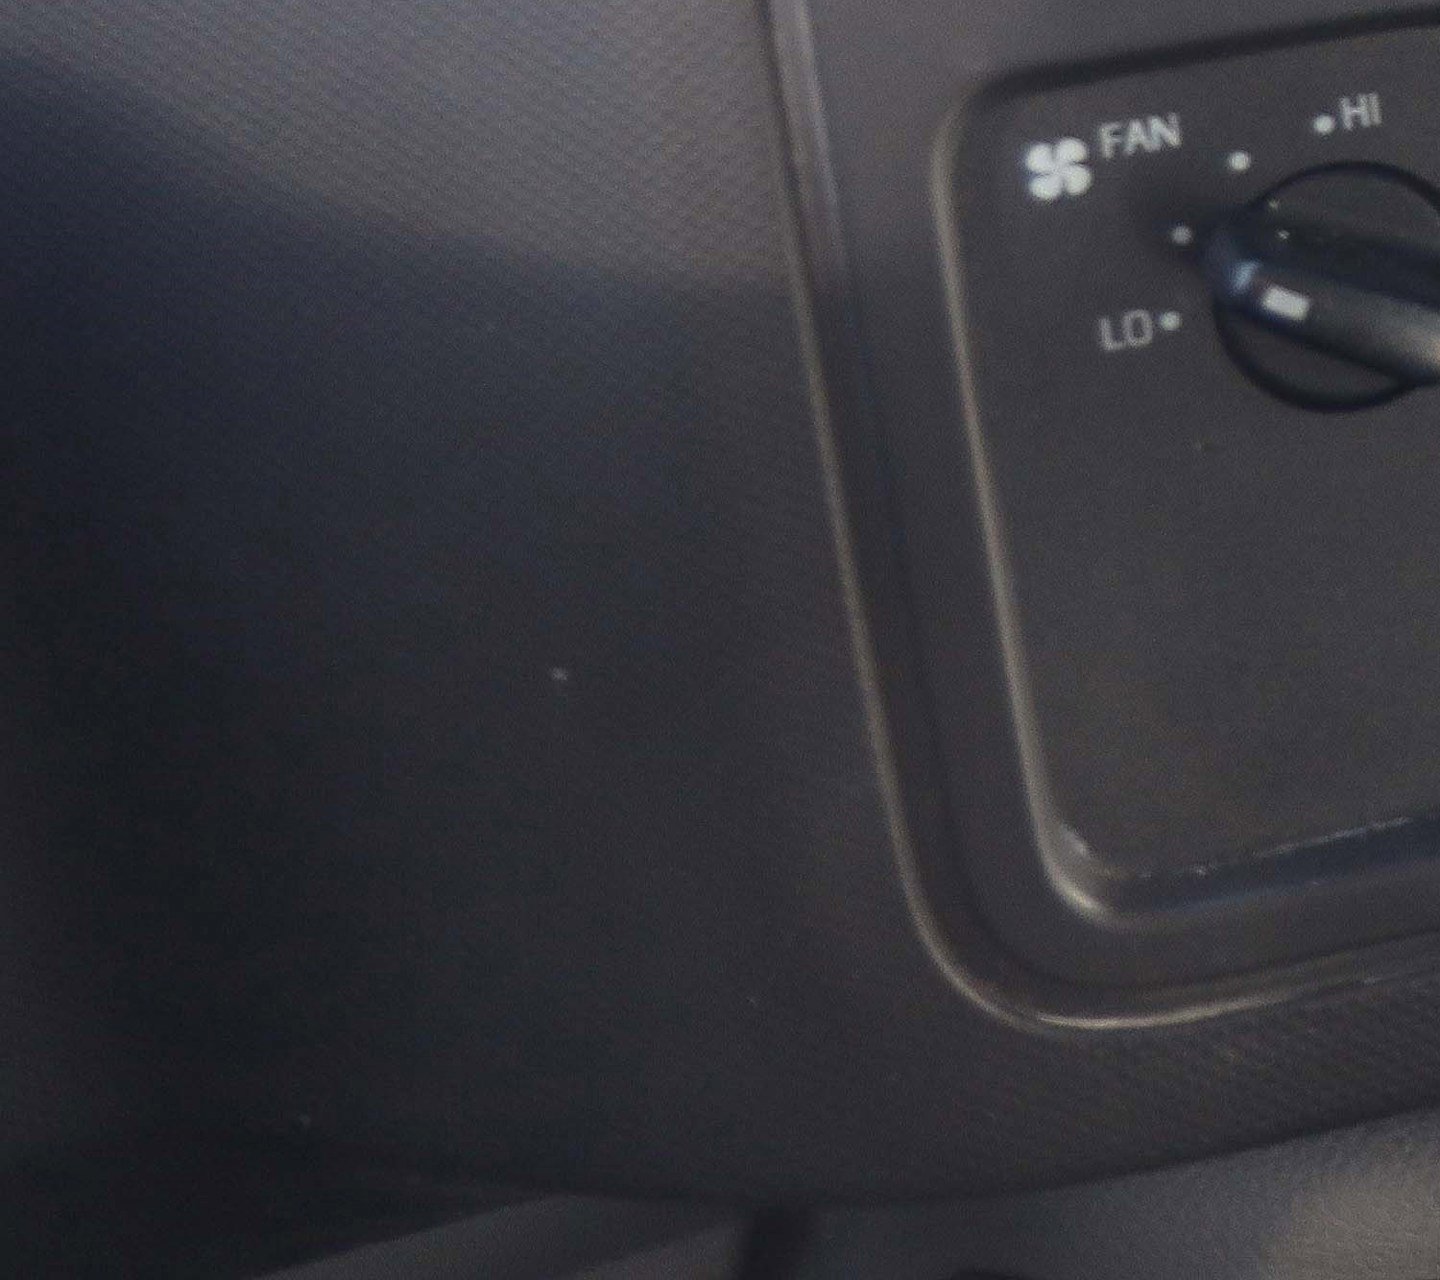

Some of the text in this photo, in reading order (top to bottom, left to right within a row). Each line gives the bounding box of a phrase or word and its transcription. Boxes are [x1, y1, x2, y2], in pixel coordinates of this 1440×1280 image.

[1342, 96, 1378, 128] HI
[1101, 117, 1179, 156] FAN
[1100, 310, 1152, 350] LO
